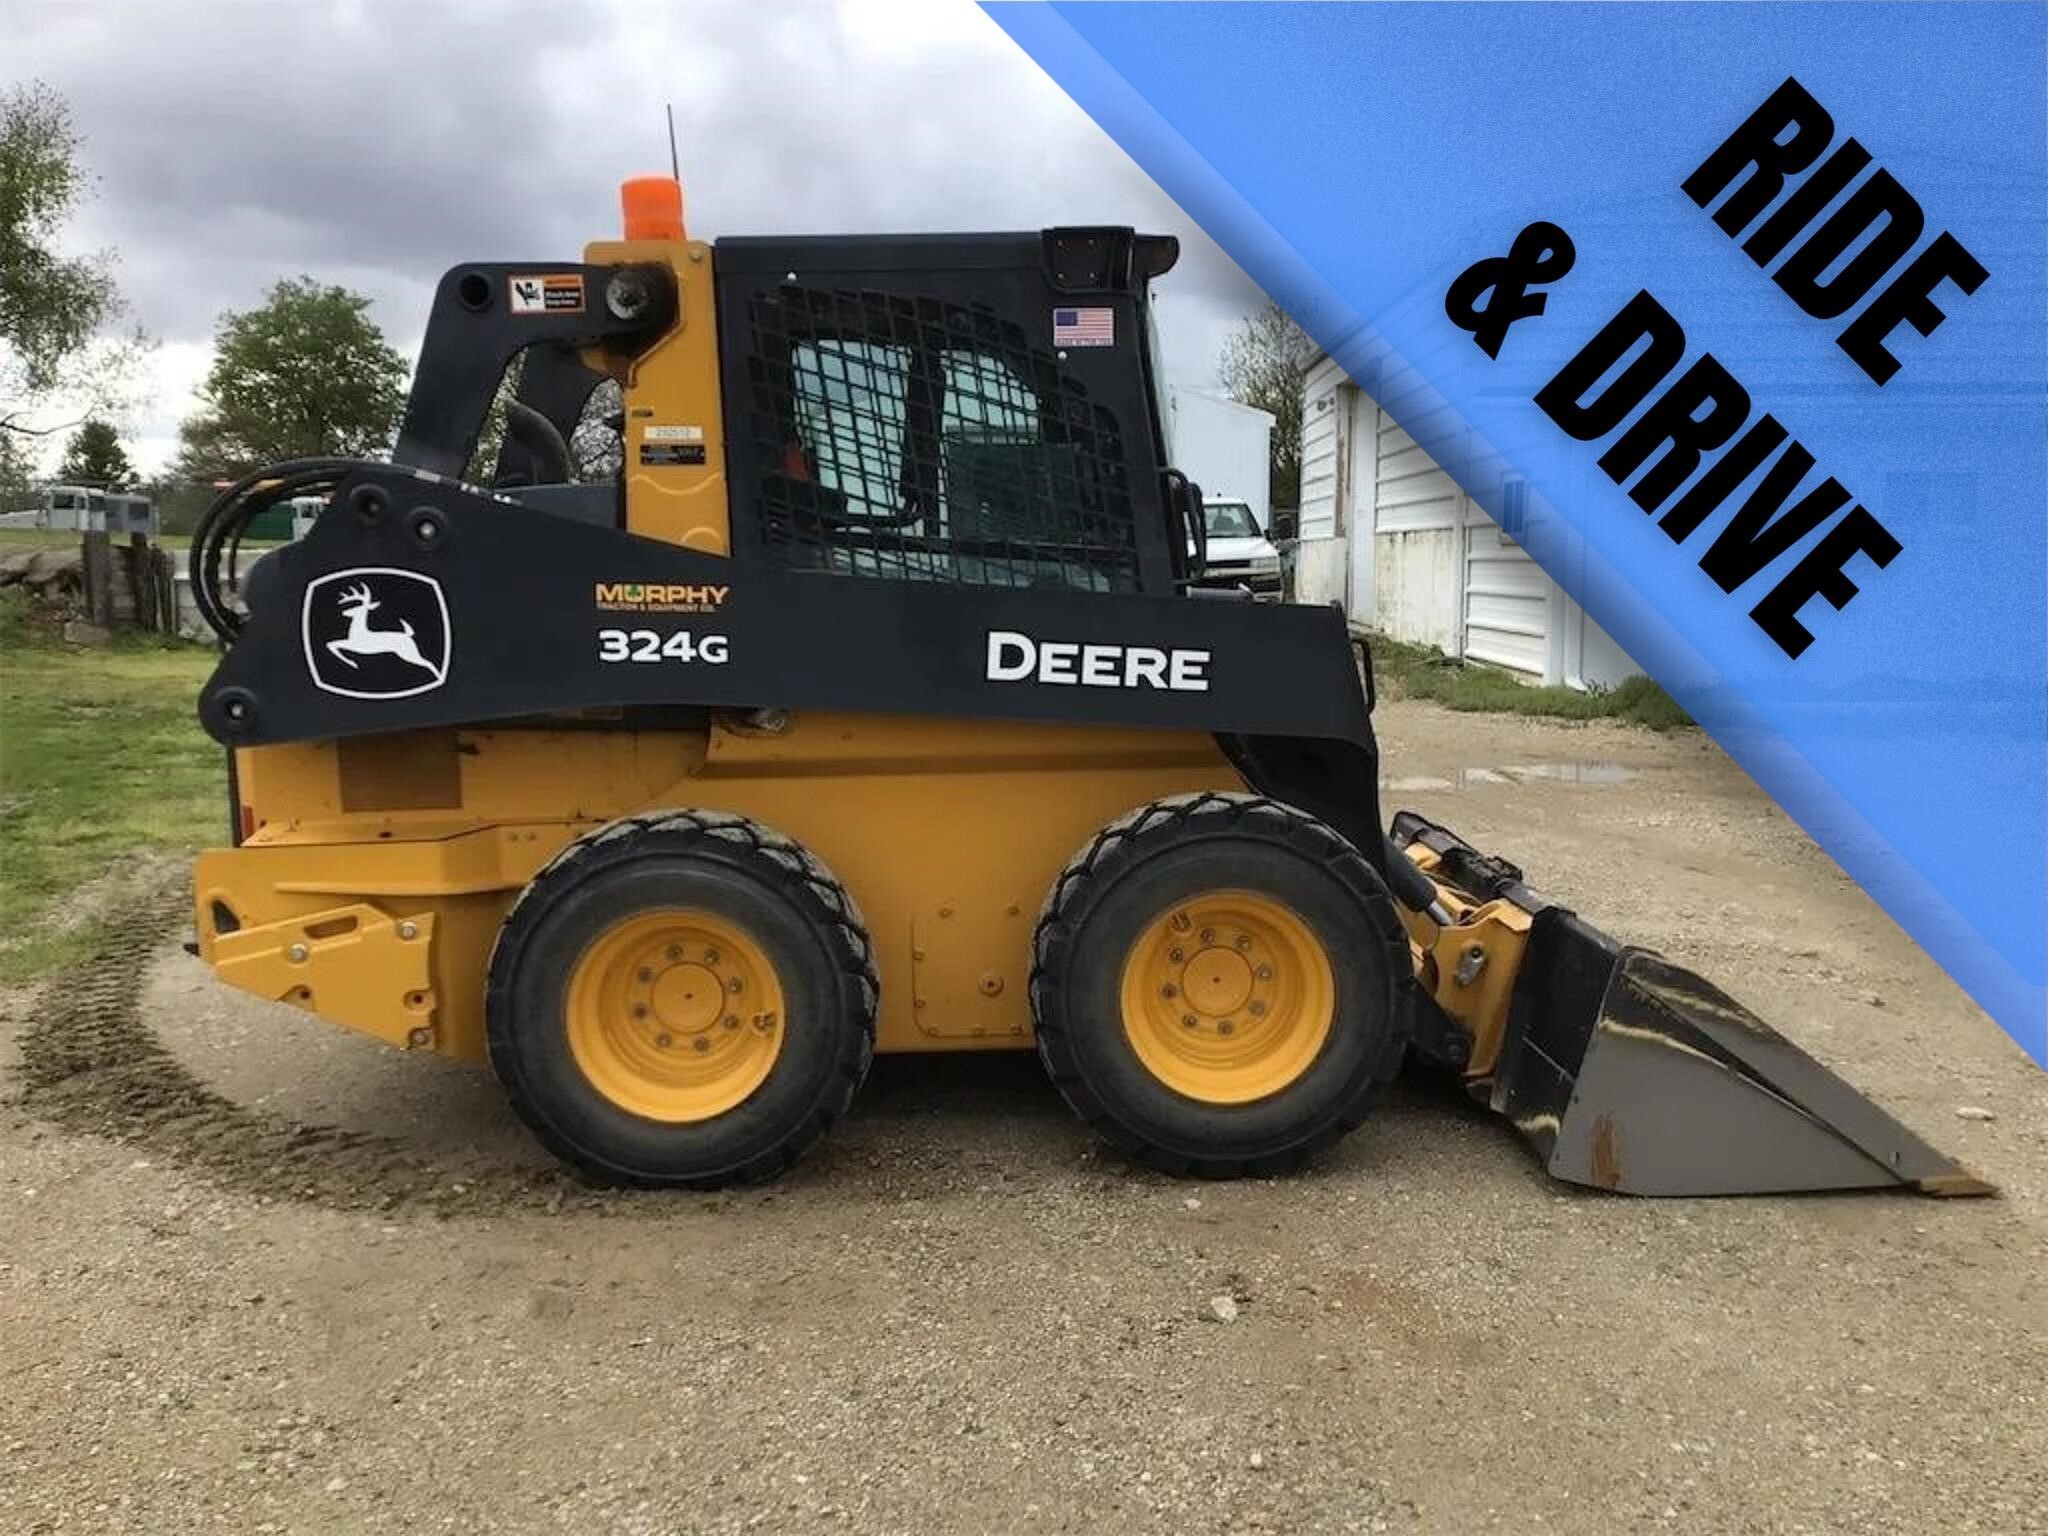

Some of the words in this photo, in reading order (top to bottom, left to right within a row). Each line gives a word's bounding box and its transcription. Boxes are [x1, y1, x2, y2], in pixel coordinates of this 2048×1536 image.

[595, 583, 729, 604] MURPHY
[599, 629, 729, 663] 324G
[987, 631, 1211, 691] DEERE
